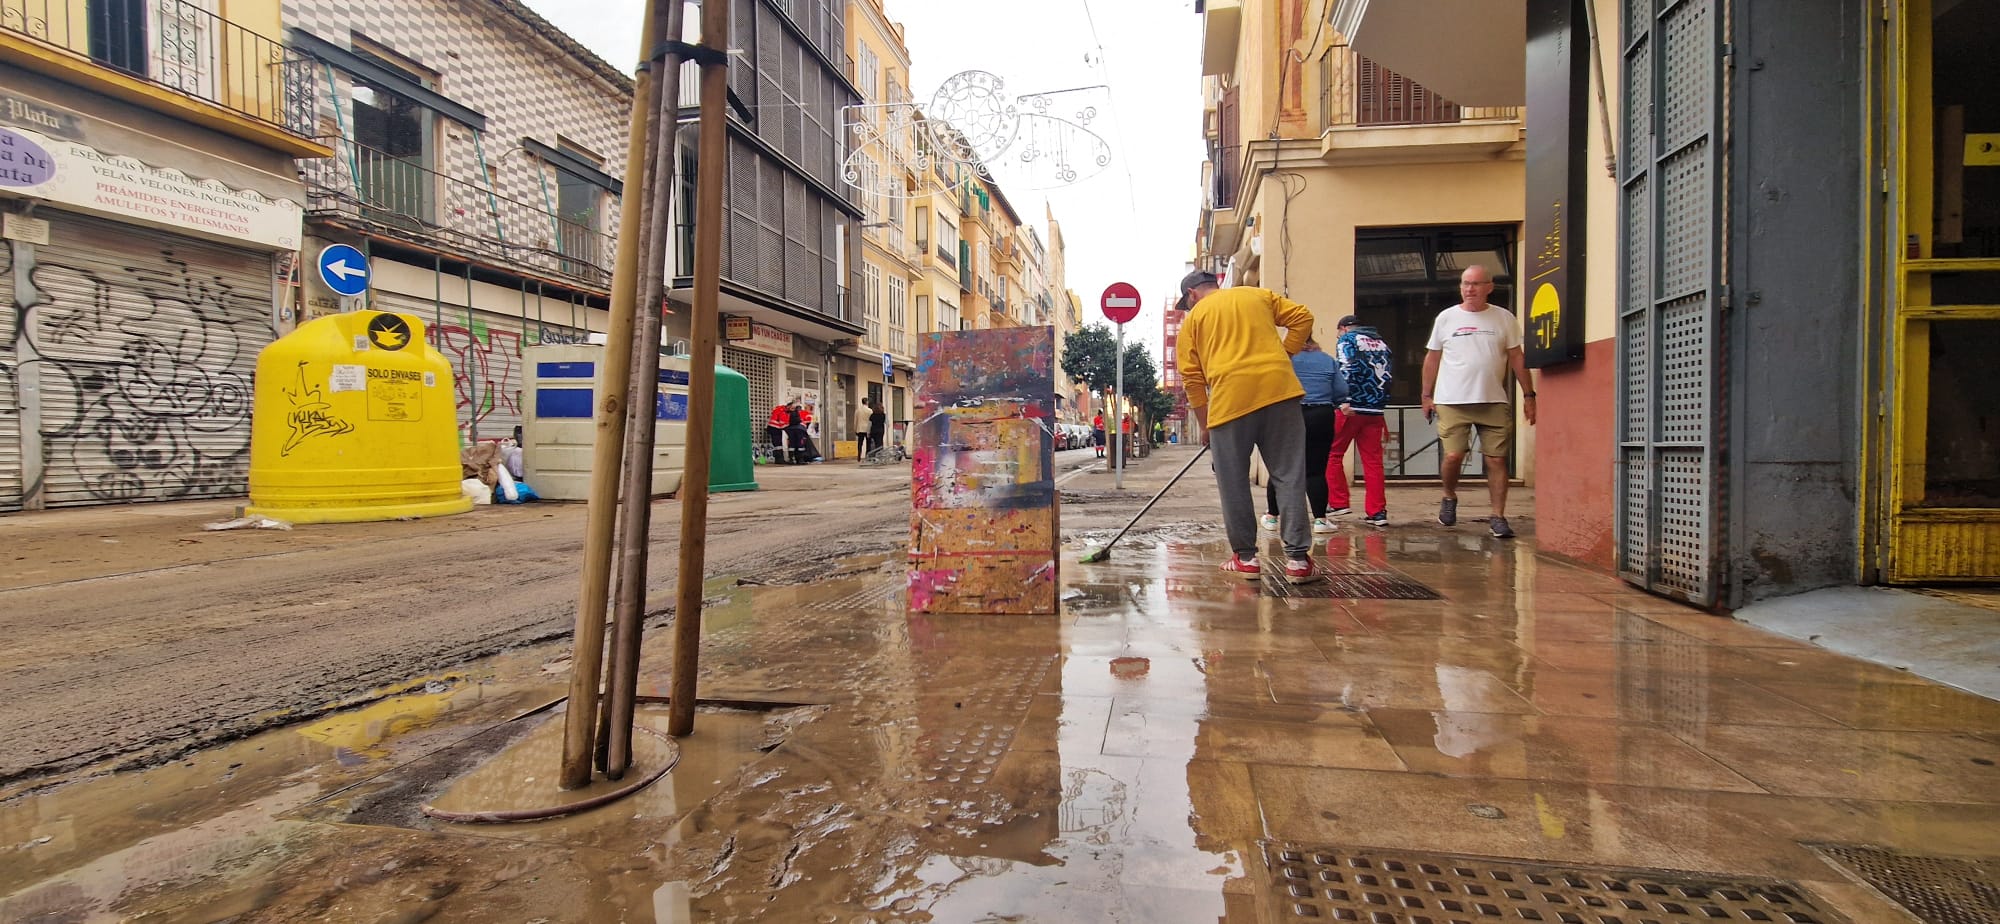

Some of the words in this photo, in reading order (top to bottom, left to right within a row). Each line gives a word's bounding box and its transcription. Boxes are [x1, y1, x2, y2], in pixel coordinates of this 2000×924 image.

[7, 98, 60, 129] Plata
[24, 151, 49, 169] de
[0, 168, 33, 184] ata
[70, 147, 135, 170] ESENCIAS
[139, 164, 147, 174] Y
[150, 168, 212, 190] PERFUMES
[215, 184, 276, 207] ESPECIALES
[94, 194, 167, 217] AMULETOS
[169, 210, 178, 219] Y
[181, 214, 249, 234] TALISMANES
[96, 182, 167, 205] PIRÁMIDES
[170, 199, 249, 224] ENERGÉTICAS
[200, 192, 260, 212] INCIENSOS
[367, 368, 390, 378] SOLO
[391, 369, 422, 381] ENVASES
